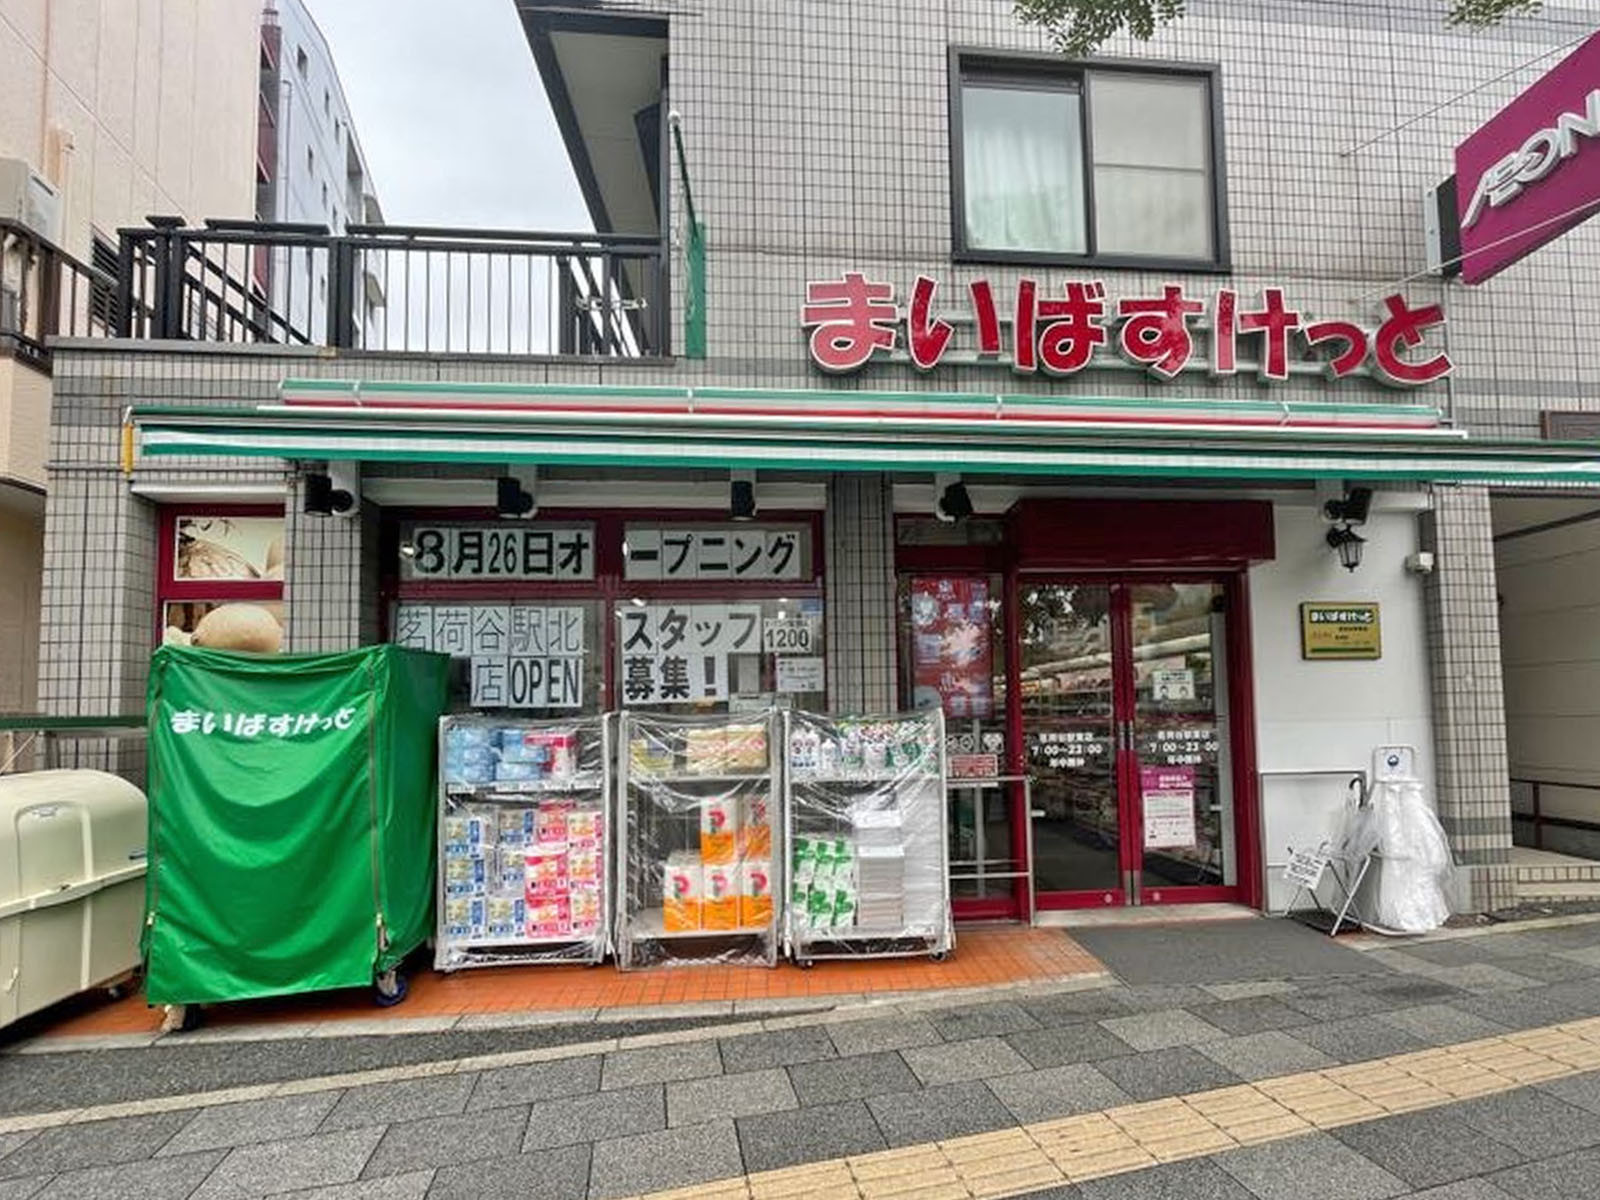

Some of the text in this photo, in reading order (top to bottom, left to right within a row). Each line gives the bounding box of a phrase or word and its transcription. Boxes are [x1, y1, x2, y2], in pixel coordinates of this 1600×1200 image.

[802, 271, 1454, 384] まいばすけっと
[414, 529, 797, 575] 8月26日オ ープニング
[400, 608, 580, 653] 茗荷谷駅北
[623, 609, 758, 652] スタッフ
[766, 628, 809, 648] 1200
[170, 707, 356, 737] まいばすけっと
